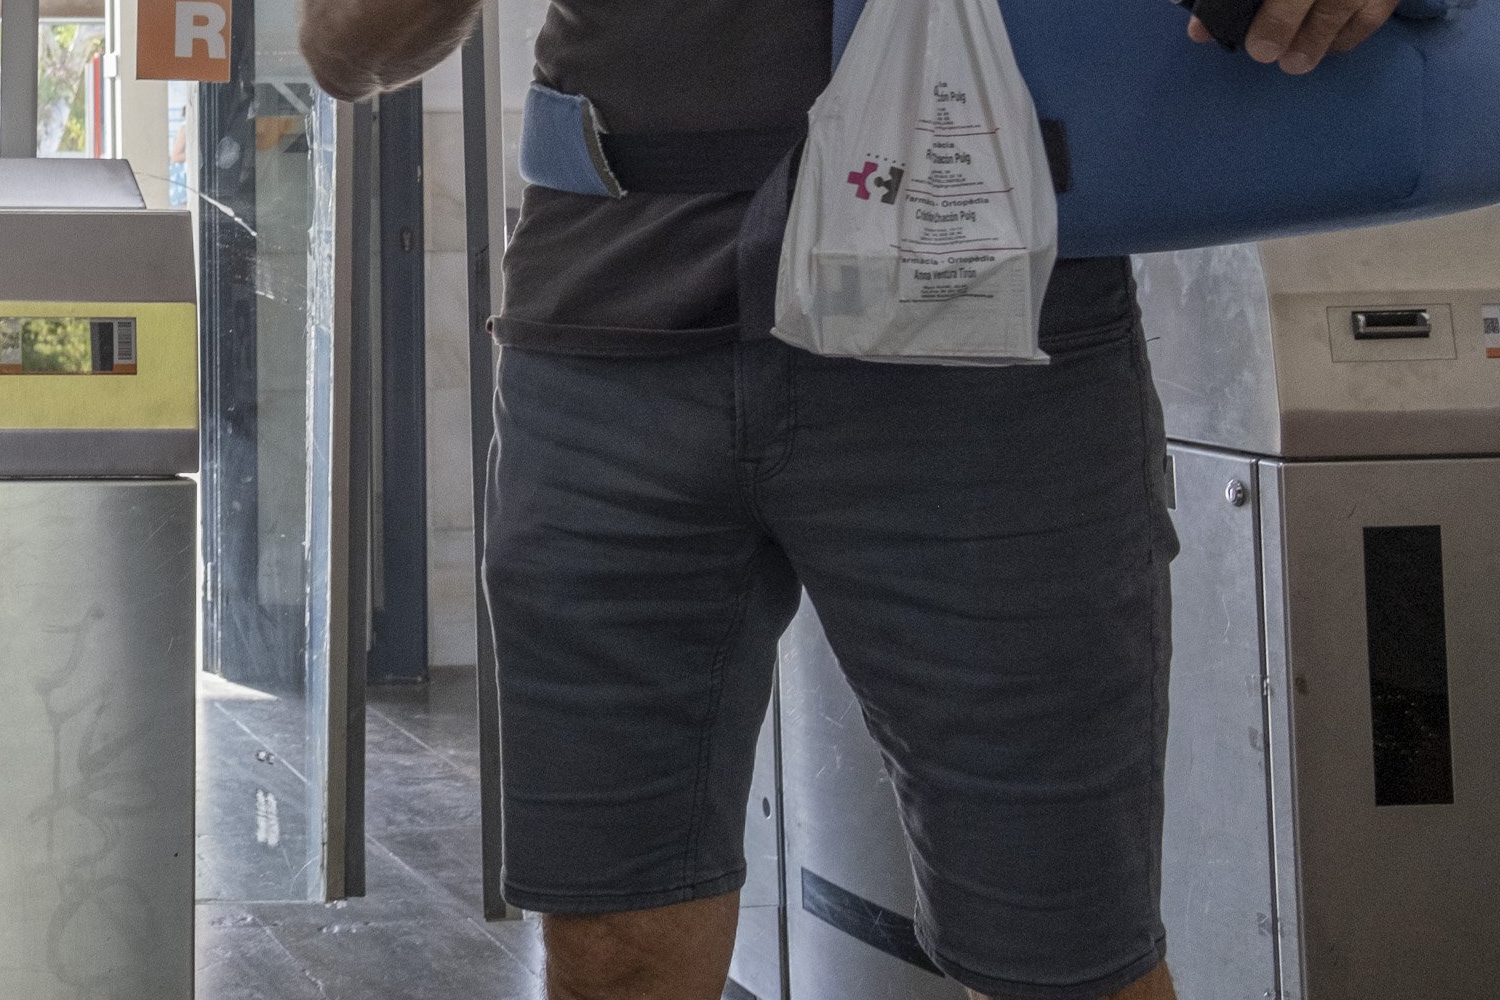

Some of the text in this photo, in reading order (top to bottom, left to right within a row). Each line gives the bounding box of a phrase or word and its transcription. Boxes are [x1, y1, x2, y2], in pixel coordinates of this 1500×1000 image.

[175, 1, 227, 59] R
[950, 91, 966, 104] Puig
[954, 152, 971, 165] Puig
[960, 210, 976, 222] Puig
